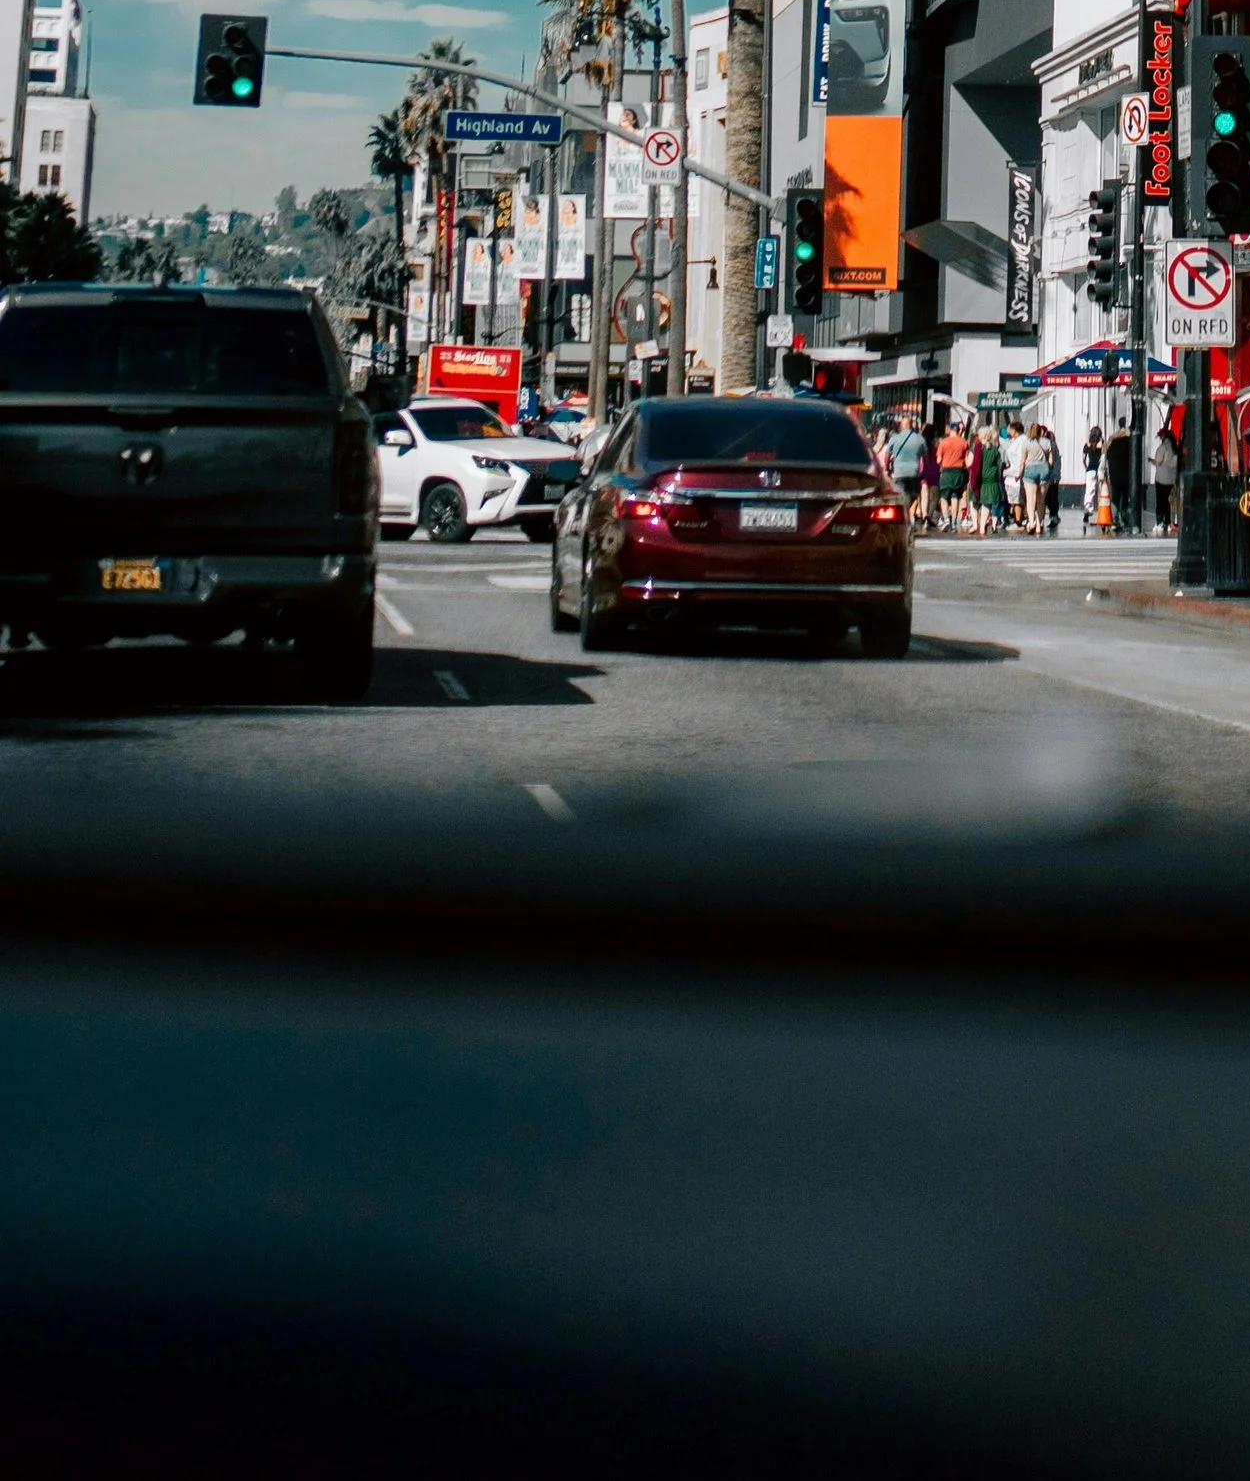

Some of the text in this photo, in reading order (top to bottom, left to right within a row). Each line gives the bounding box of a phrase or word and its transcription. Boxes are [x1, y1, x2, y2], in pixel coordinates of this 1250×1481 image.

[455, 117, 551, 137] Highland Av
[1145, 20, 1172, 196] Foot Locker
[1012, 170, 1034, 225] ICONS
[1008, 237, 1032, 324] DARKNESS
[1172, 318, 1192, 335] ON
